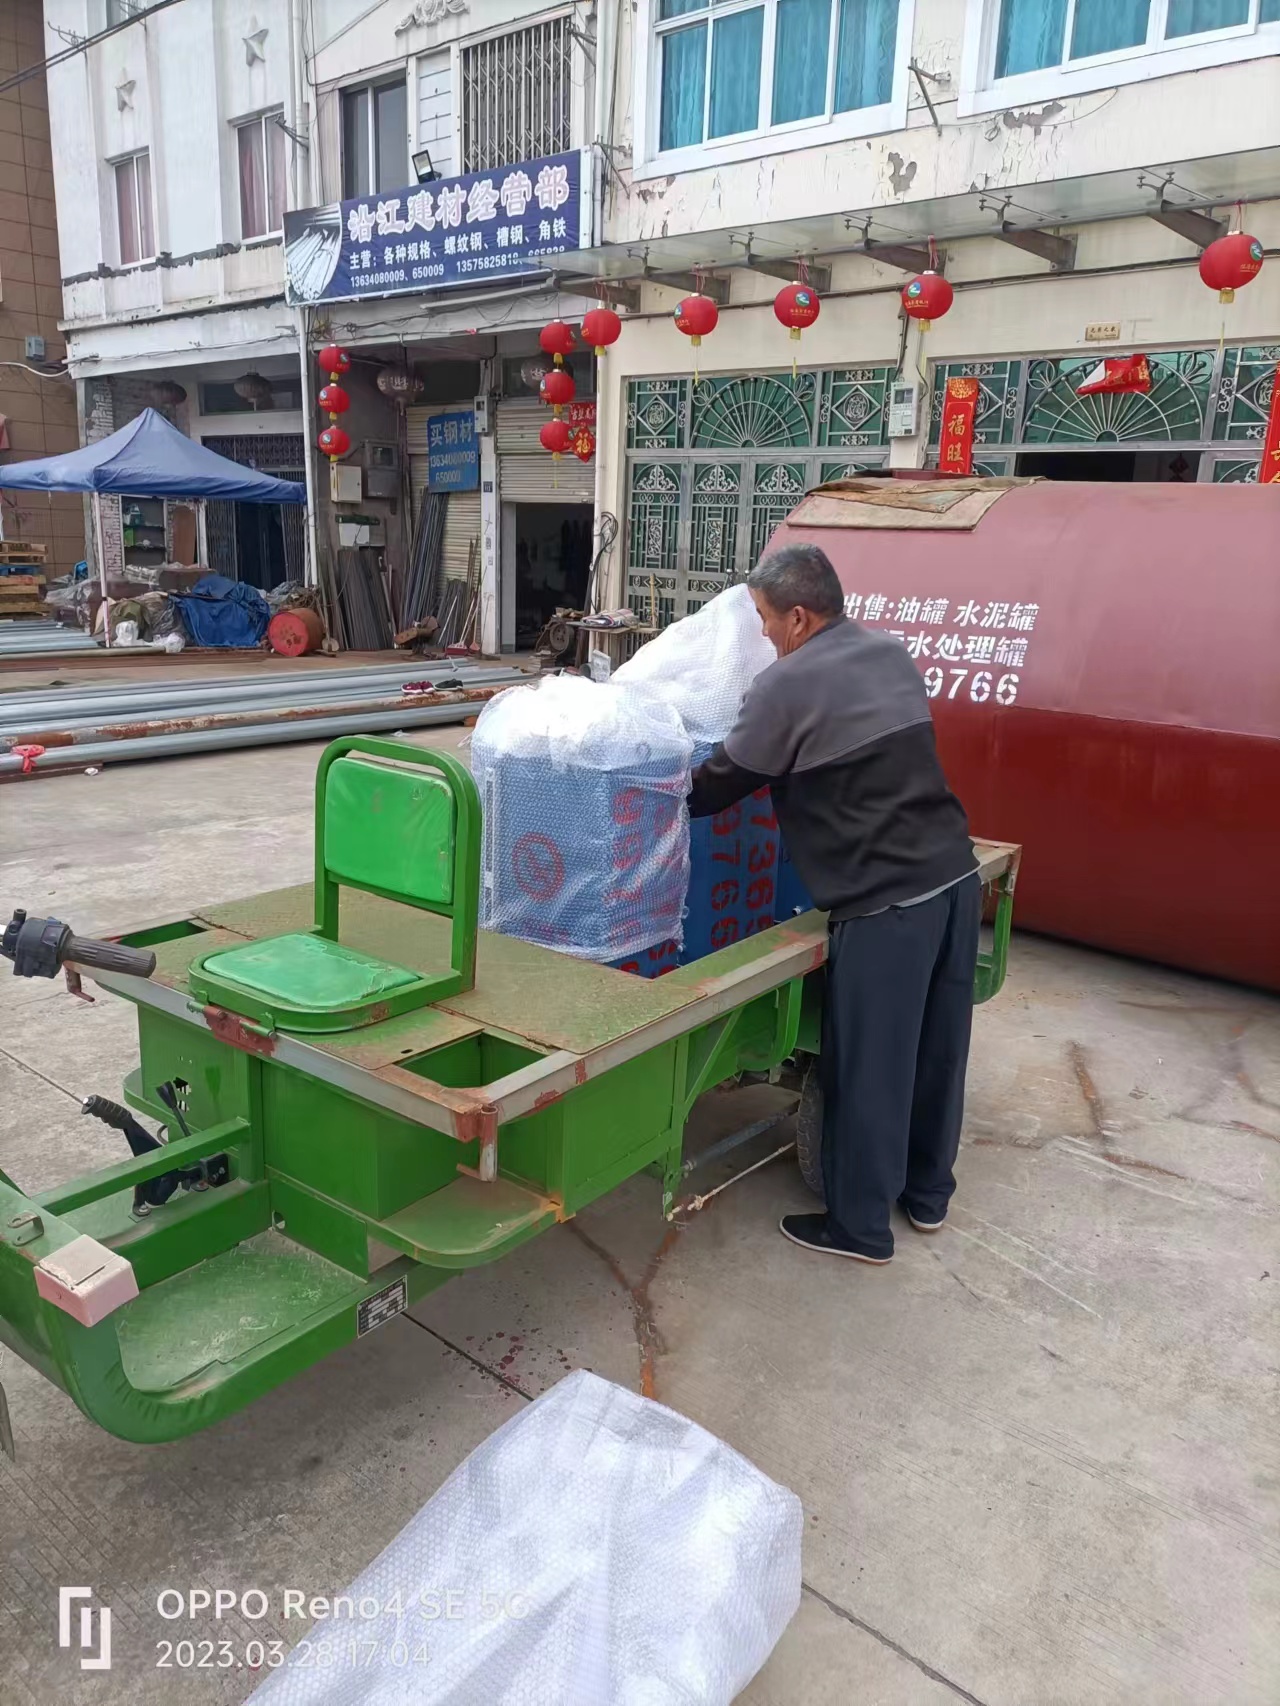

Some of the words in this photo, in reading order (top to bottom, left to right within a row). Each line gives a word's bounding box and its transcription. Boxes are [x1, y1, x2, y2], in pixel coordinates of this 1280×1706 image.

[348, 165, 569, 243] 沿江建材经营部
[953, 600, 1040, 631] 水泥罐
[884, 629, 1029, 667] 水处理罐
[924, 666, 1020, 706] 9766
